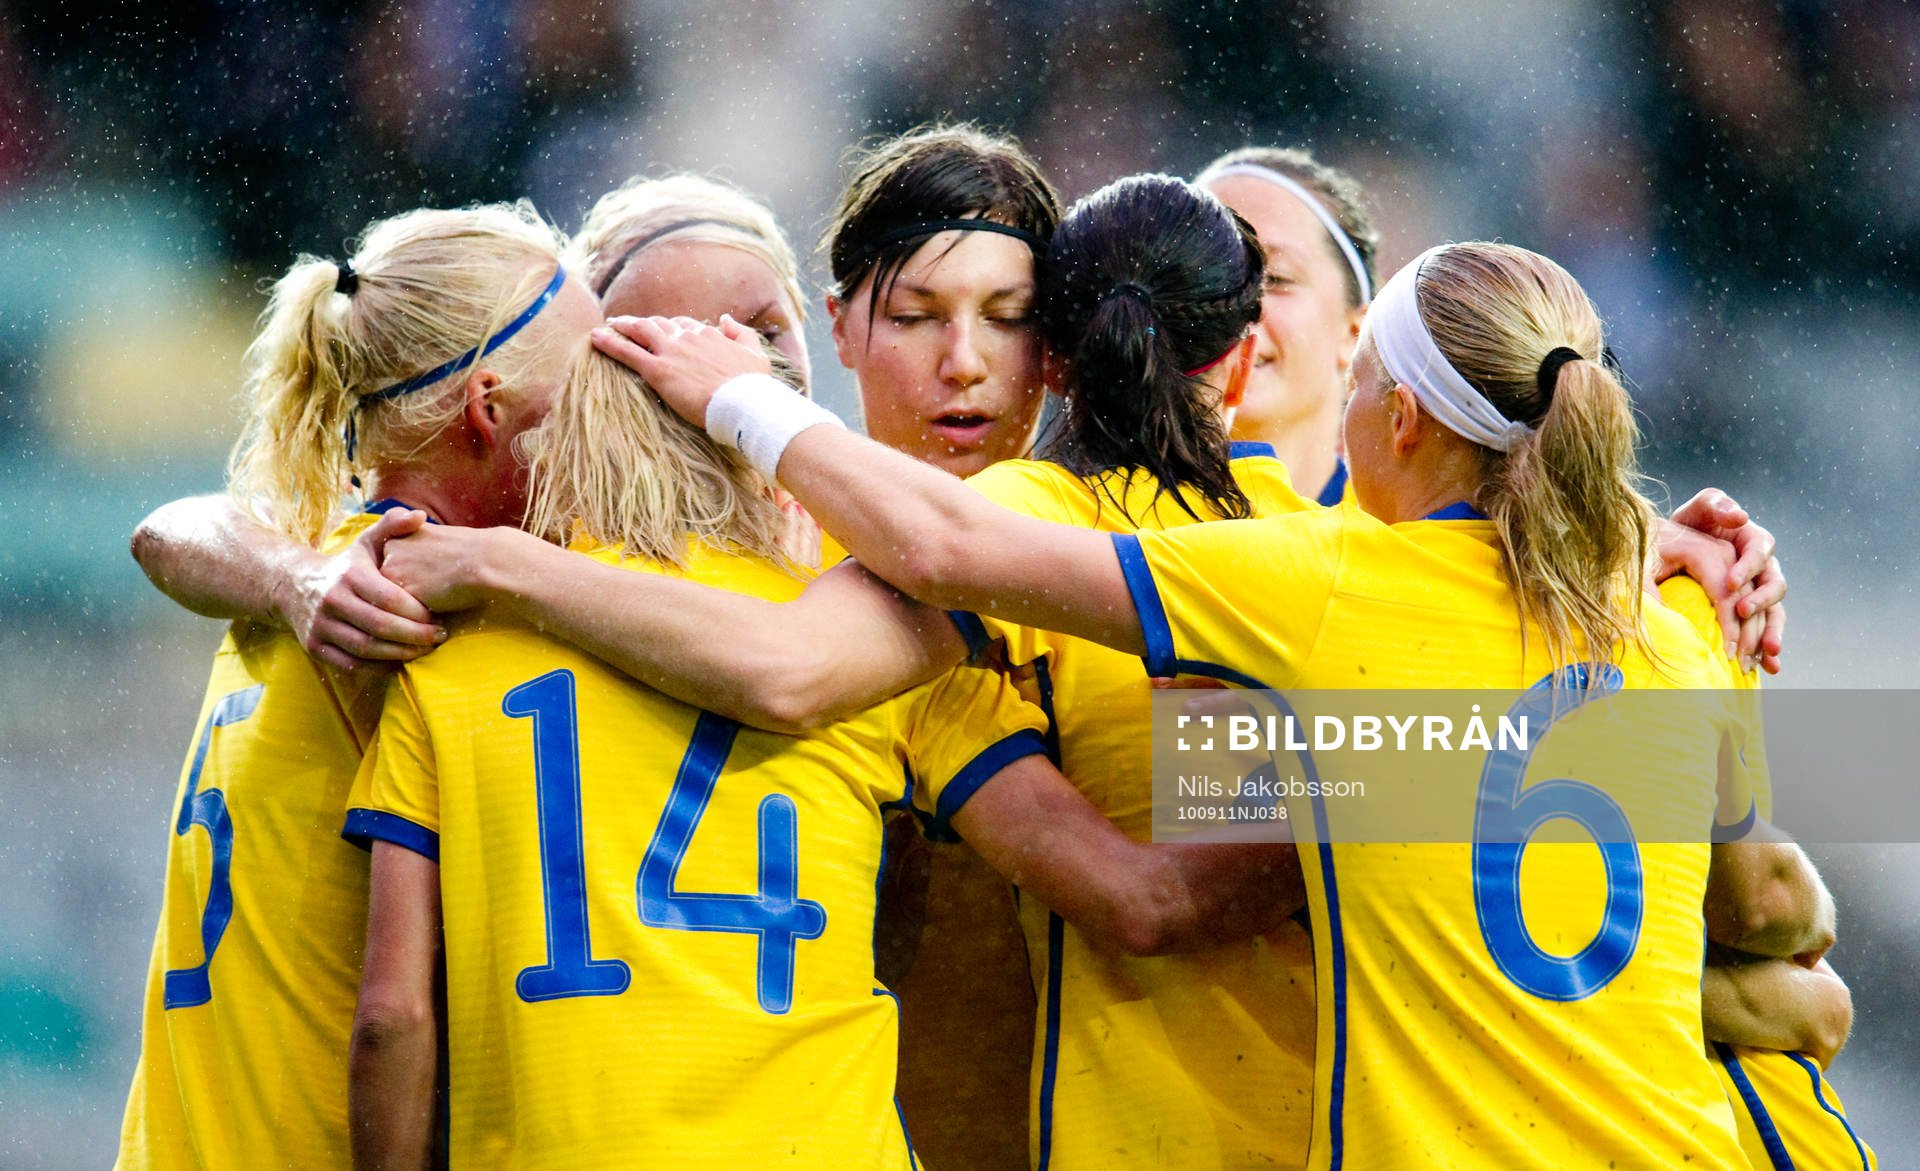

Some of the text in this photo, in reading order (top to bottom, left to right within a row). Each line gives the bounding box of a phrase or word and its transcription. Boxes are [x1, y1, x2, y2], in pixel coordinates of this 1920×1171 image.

[163, 683, 265, 1010] 5
[503, 669, 827, 1014] 14
[1472, 661, 1643, 1002] 6
